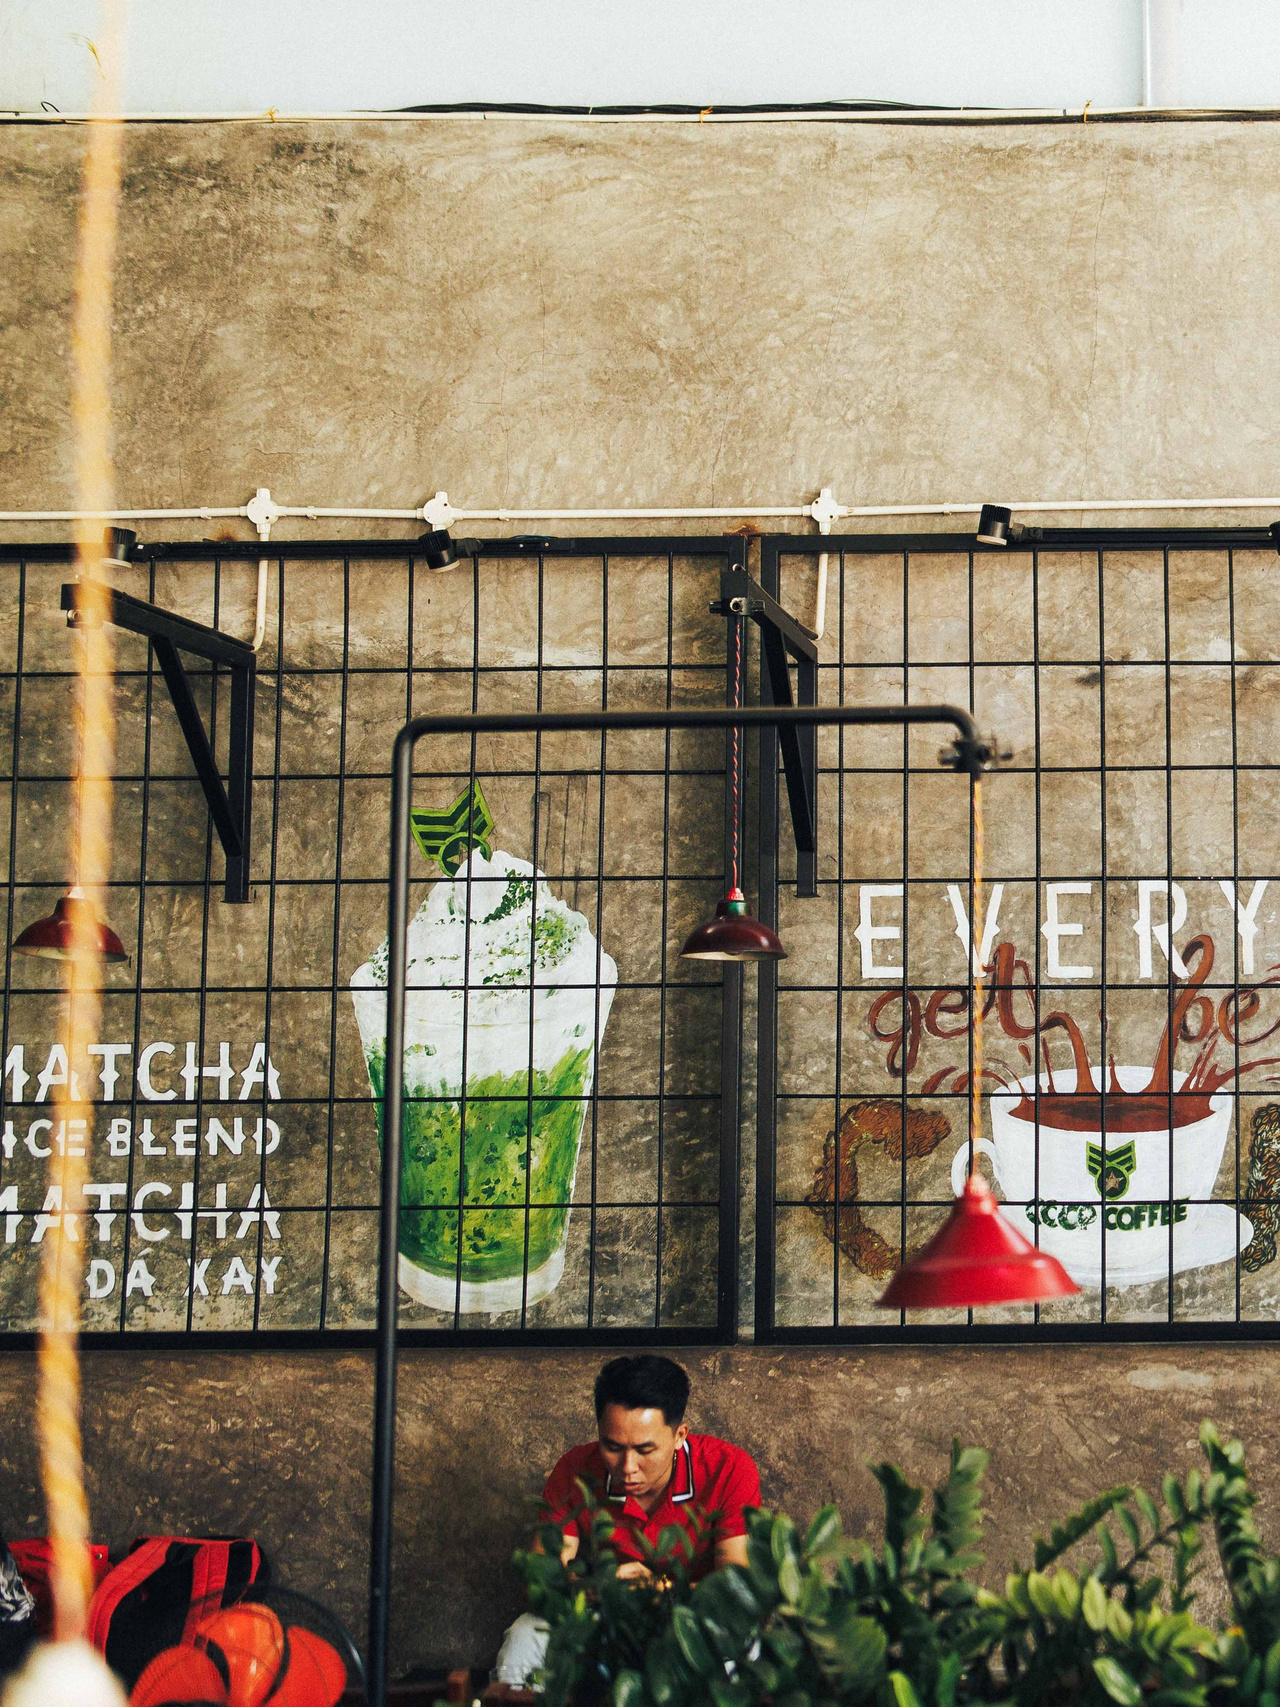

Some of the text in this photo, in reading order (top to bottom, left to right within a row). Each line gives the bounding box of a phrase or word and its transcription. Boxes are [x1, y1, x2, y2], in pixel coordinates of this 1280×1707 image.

[867, 942, 1040, 1078] get
[2, 1117, 281, 1158] ICE BLEND
[1104, 1196, 1191, 1231] COFFEE
[184, 1256, 283, 1296] XAY
